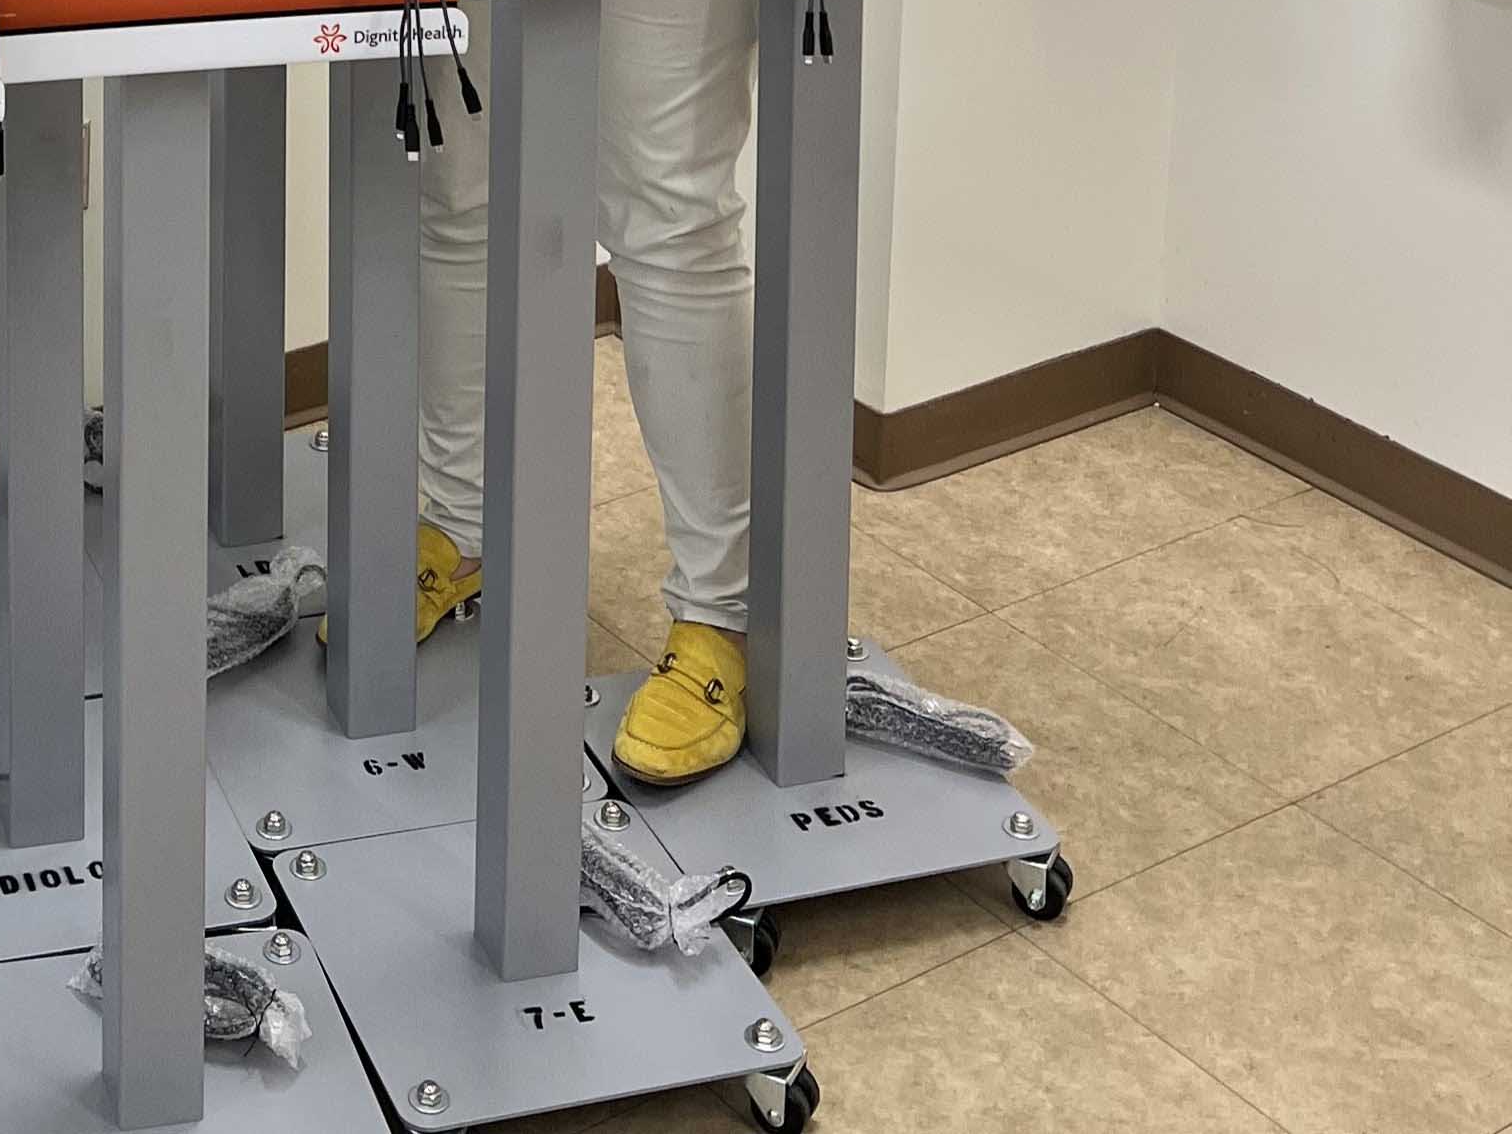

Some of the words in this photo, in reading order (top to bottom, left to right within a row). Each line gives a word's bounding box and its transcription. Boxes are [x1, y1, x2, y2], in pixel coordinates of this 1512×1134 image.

[363, 752, 426, 776] 6-W
[790, 800, 884, 832] PEDS
[523, 1000, 596, 1030] 7-E
